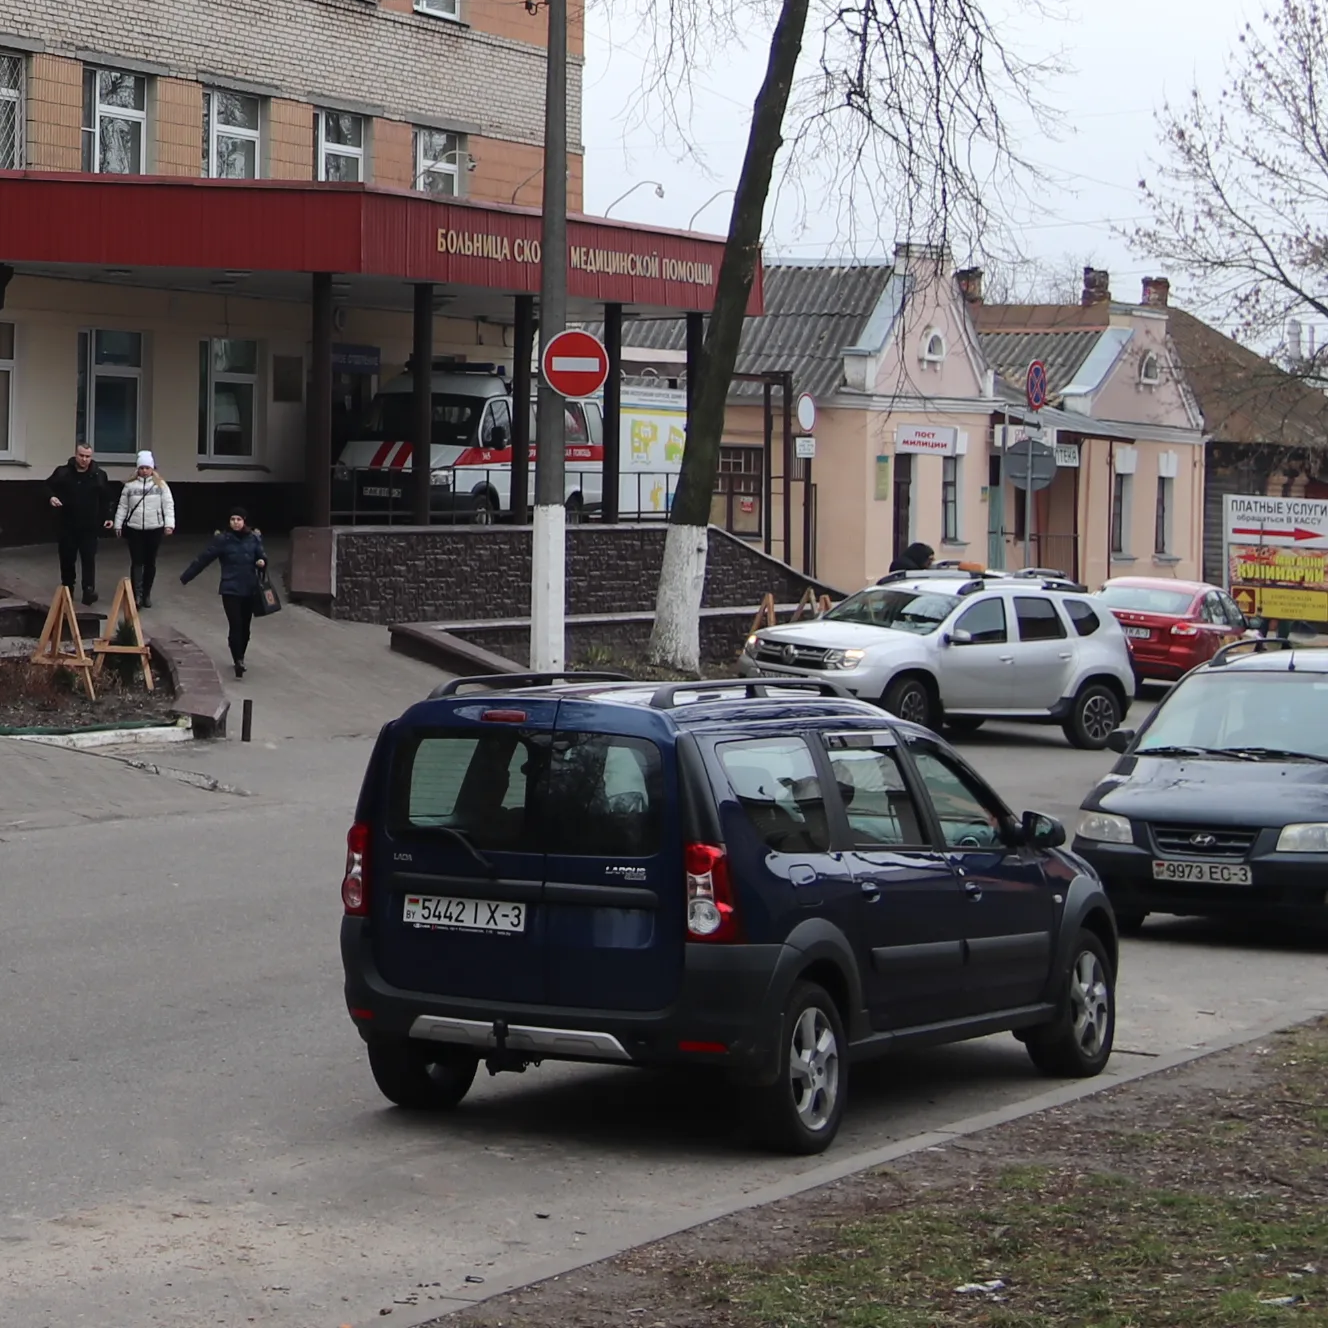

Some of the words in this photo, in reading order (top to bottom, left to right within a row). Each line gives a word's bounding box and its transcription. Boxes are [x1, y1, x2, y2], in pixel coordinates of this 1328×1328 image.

[437, 229, 511, 262] БОЛЬНИЦА
[570, 246, 660, 279] МЕДИЦИНСКОЙ
[662, 257, 714, 286] ПОМОЩИ
[915, 431, 936, 439] ПОСТ
[902, 440, 947, 449] МИЛИЦИИ
[1055, 447, 1077, 465] ПТЕКА
[1231, 499, 1283, 515] ПЛАТНЫЕ
[1286, 503, 1327, 517] УСЛУГИ
[1237, 514, 1284, 523] обращаться
[1294, 517, 1322, 525] КАССУ
[1239, 564, 1324, 582] КУЛИНАРИИ
[393, 852, 412, 861] LADA
[1166, 863, 1203, 880] 9973
[405, 908, 416, 919] BY
